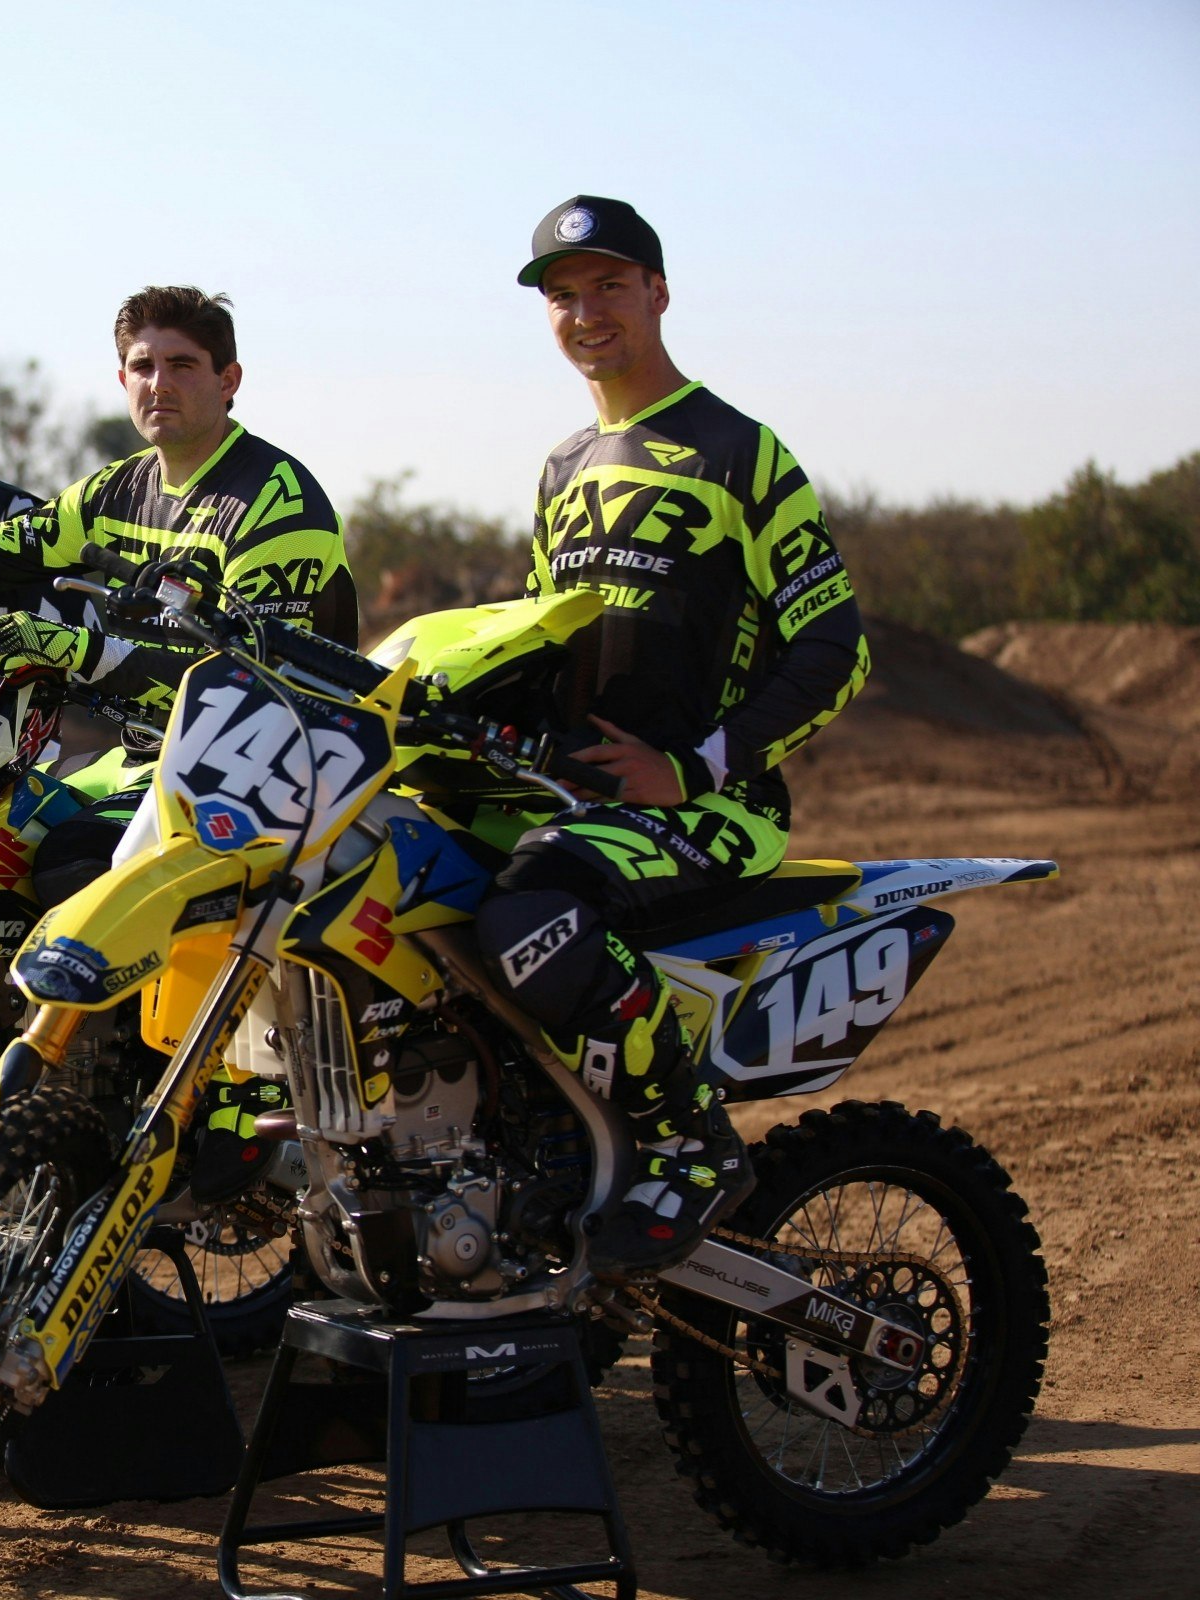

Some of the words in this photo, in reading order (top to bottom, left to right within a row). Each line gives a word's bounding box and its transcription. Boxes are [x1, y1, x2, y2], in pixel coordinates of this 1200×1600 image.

[551, 480, 712, 553] FXR
[231, 558, 324, 603] FXR
[605, 548, 674, 575] RIDE
[787, 582, 841, 627] RACE
[165, 685, 365, 823] 149
[669, 833, 712, 870] RIDE
[874, 879, 953, 909] DUNLOP
[506, 915, 576, 978] FXR
[104, 950, 163, 993] SUZUKI
[359, 998, 404, 1024] FXR
[757, 927, 910, 1065] 149
[60, 1165, 156, 1336] DUNLOP
[686, 1259, 771, 1298] REKLUSE
[804, 1297, 856, 1333] Mika
